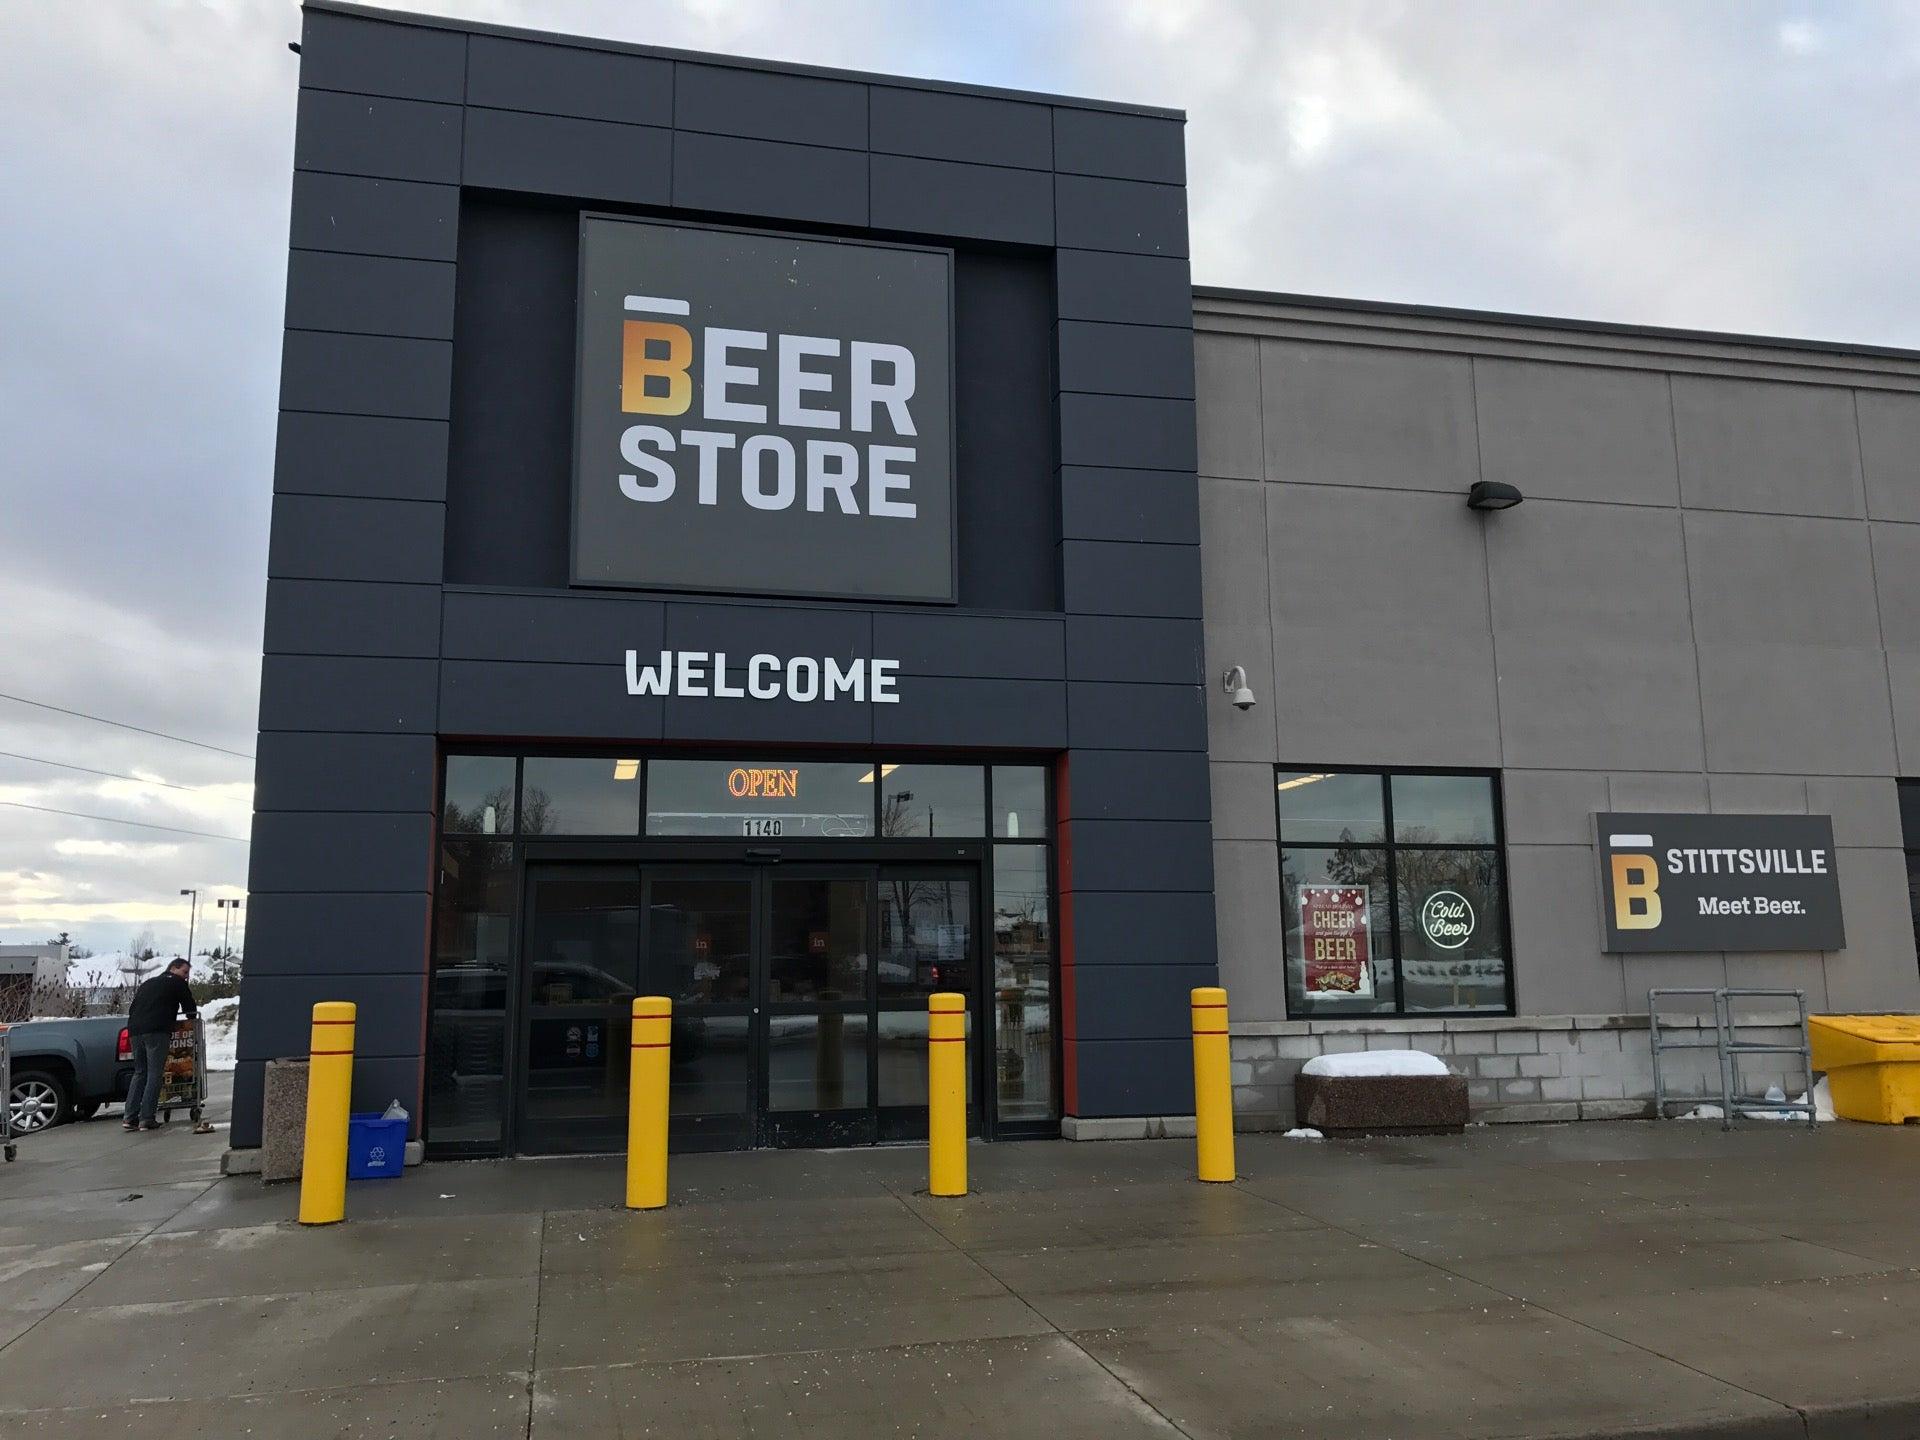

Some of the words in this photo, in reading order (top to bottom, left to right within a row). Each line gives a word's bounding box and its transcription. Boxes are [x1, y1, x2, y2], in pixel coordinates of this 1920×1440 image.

[621, 319, 918, 437] BEER
[618, 424, 918, 519] STORE
[625, 650, 900, 703] WELCOME
[728, 768, 799, 797] OPEN
[745, 820, 781, 836] 1140
[1667, 848, 1828, 874] STITTSVILLE
[1611, 854, 1662, 929] B
[1430, 901, 1465, 918] Cold
[1698, 897, 1751, 915] Meet
[1754, 897, 1806, 915] Beer.
[1313, 911, 1356, 928] CHEER
[1430, 919, 1470, 937] Beer
[695, 939, 707, 949] in
[813, 937, 825, 947] in
[1314, 938, 1357, 960] BEER
[182, 1030, 194, 1039] OF
